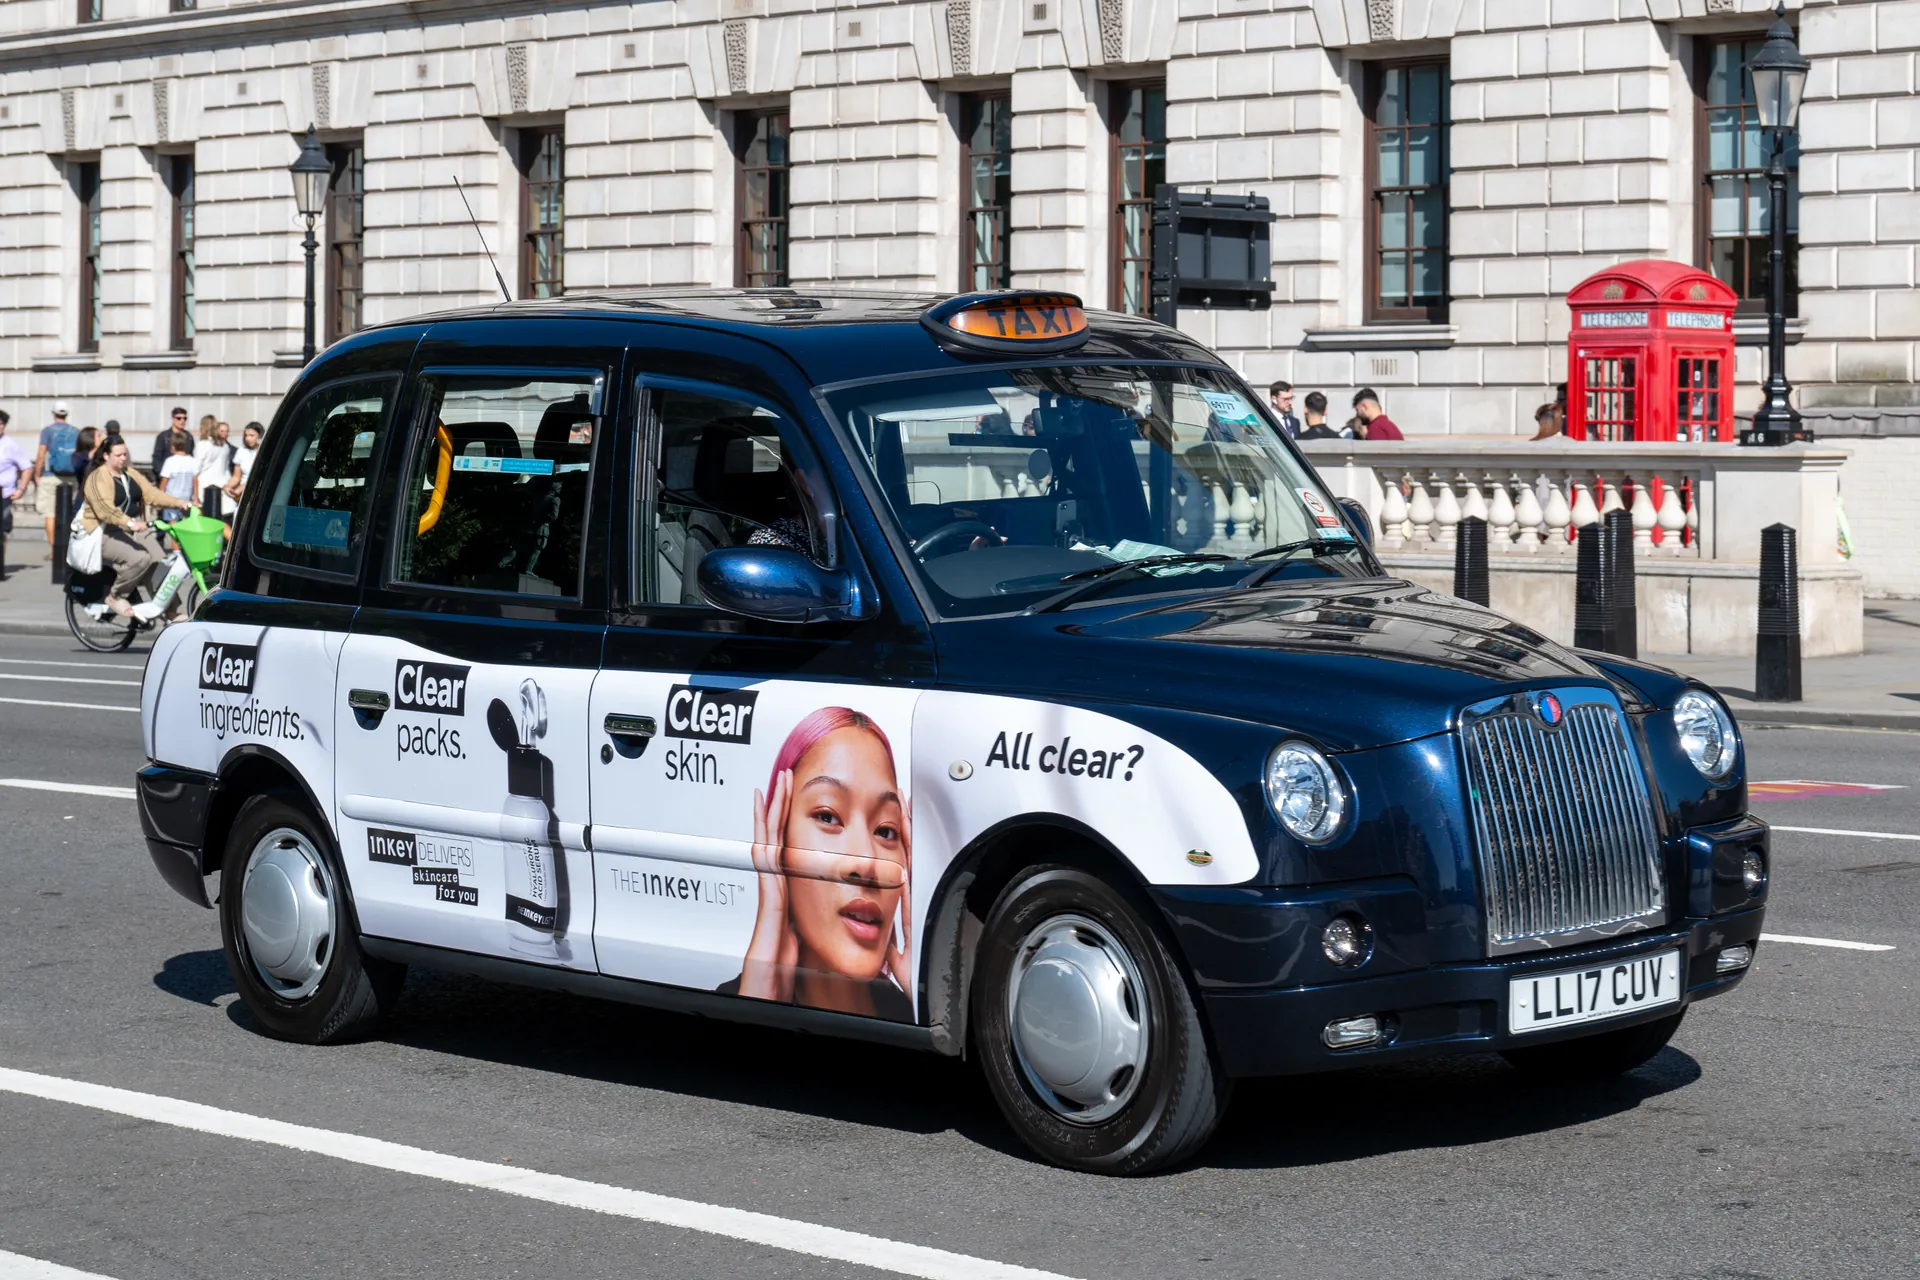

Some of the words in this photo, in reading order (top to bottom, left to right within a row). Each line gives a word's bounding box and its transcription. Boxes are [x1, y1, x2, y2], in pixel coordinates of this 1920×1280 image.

[987, 306, 1072, 336] TAXI
[1584, 311, 1648, 327] TELEPHONE
[1669, 313, 1722, 327] TELEPHONE
[202, 646, 254, 687] Clear
[397, 664, 465, 709] Clear
[200, 693, 304, 740] ingredients.
[668, 689, 752, 736] Clear
[397, 717, 467, 761] packs.
[984, 730, 1034, 771] All
[1038, 736, 1144, 782] clear?
[665, 740, 724, 785] skin.
[418, 841, 472, 868] DELIVERS
[523, 836, 538, 898] HYALURONIC
[531, 839, 541, 874] SERUM
[414, 869, 458, 883] skincare
[438, 884, 455, 900] for
[458, 890, 476, 903] you
[1533, 969, 1602, 1021] LL17
[1612, 957, 1662, 1006] CUV
